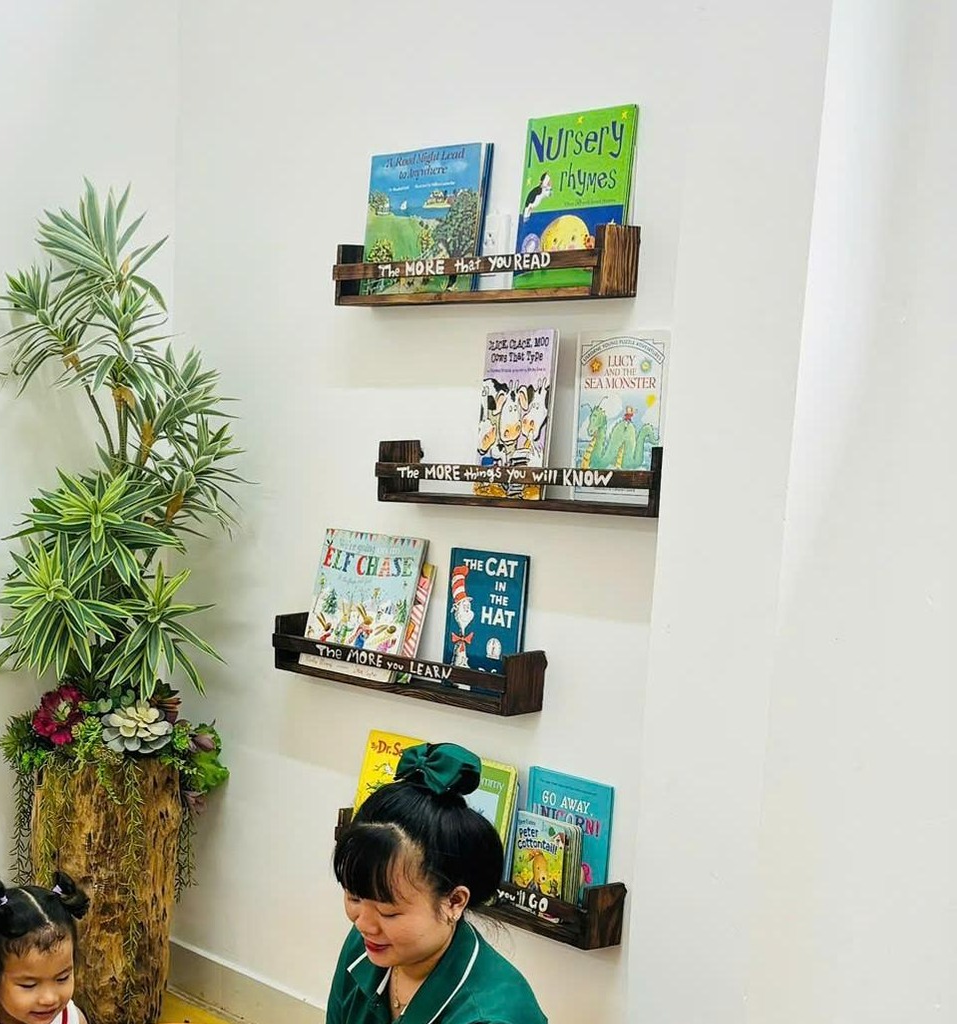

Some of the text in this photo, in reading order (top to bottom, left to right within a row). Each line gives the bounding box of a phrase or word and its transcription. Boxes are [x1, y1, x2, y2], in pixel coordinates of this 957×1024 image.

[528, 120, 625, 168] Nursery
[395, 153, 416, 167] Road
[441, 148, 466, 161] Lead
[398, 170, 407, 180] to
[559, 162, 617, 197] rhymes
[378, 252, 551, 278] The MORE that YOU READ
[534, 336, 550, 347] MOO
[509, 351, 524, 362] That
[526, 350, 544, 364] Type
[608, 355, 636, 367] LUCY
[604, 366, 637, 377] AND THE
[584, 376, 656, 389] SEA MONSTER
[397, 465, 614, 487] The MORE things you will KNOW
[323, 545, 414, 577] ELF CHASE
[463, 557, 519, 578] THE CAT
[495, 581, 506, 592] IN
[489, 594, 509, 606] THE
[480, 605, 515, 628] HAT
[315, 644, 342, 660] The
[346, 649, 383, 667] MORE
[386, 661, 405, 670] you
[409, 660, 452, 680] LEARN
[376, 740, 392, 754] Dr.
[542, 790, 557, 806] GO
[519, 826, 539, 838] Peter
[528, 893, 549, 912] GO
